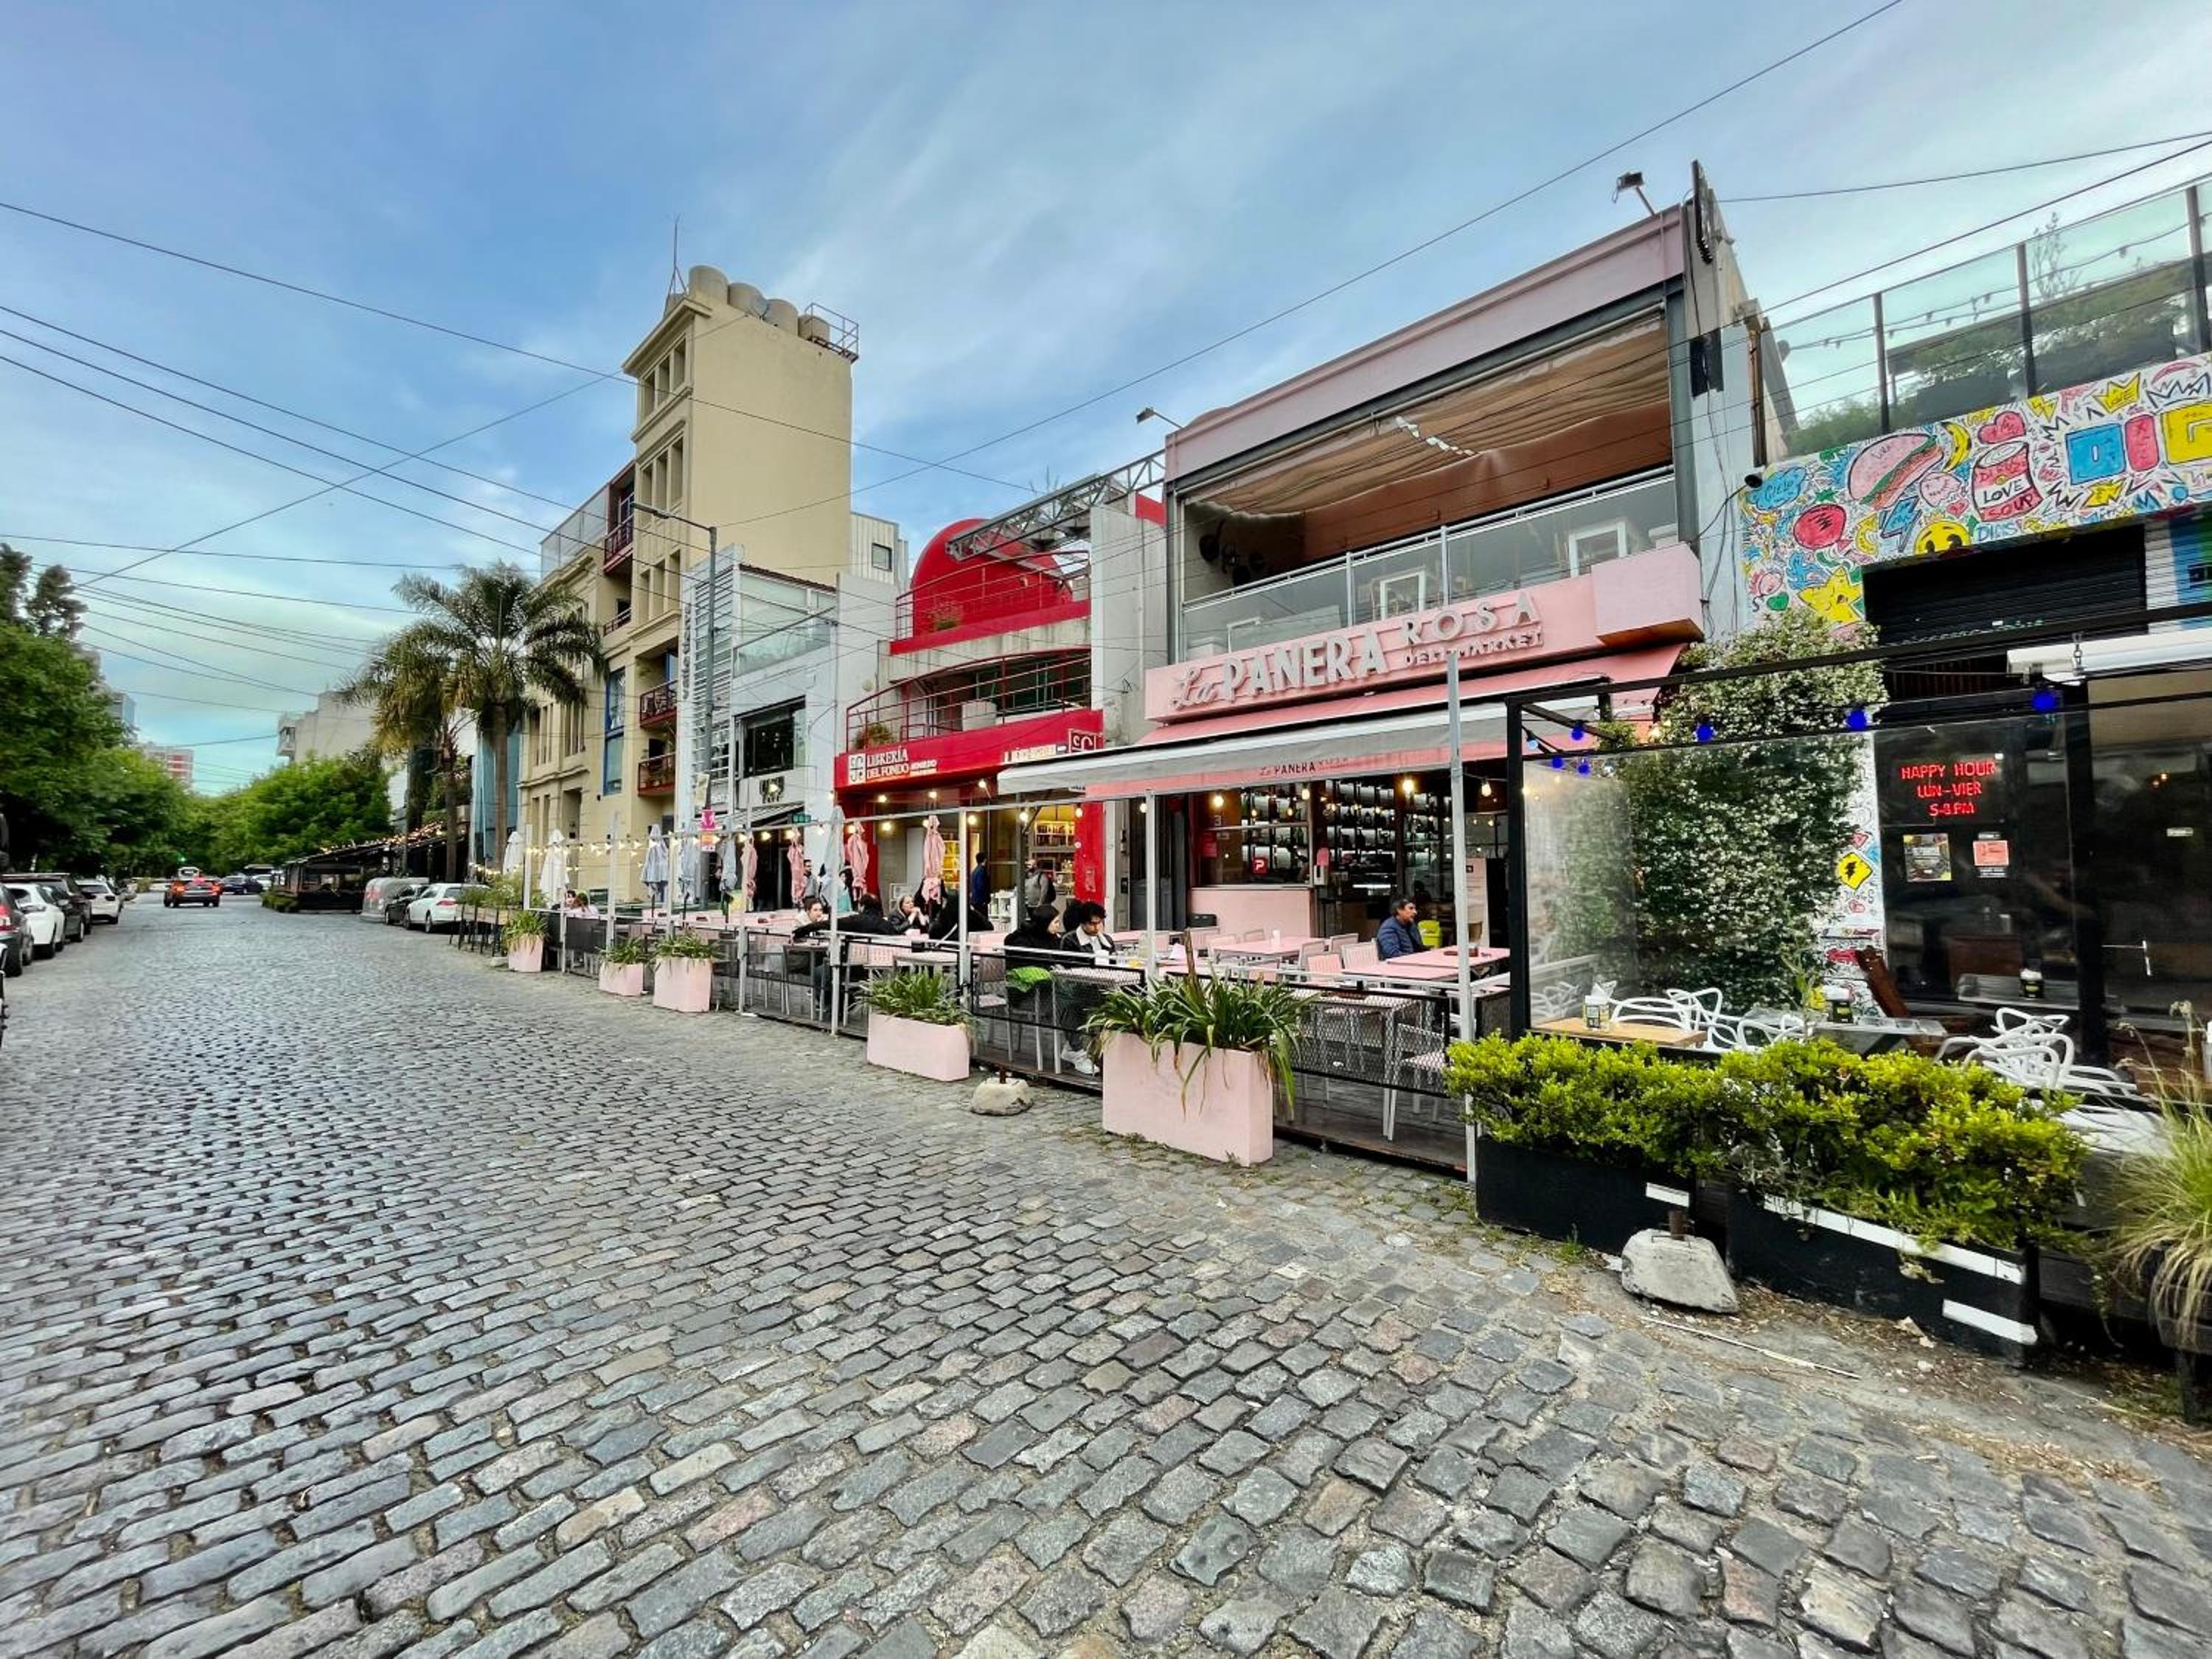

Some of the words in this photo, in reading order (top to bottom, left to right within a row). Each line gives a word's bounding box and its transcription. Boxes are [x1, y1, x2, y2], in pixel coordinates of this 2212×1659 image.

[1983, 478, 2025, 504] LOVE
[1988, 493, 2033, 516] SOUP
[1172, 667, 1217, 711] La
[1222, 627, 1390, 703] PANERA
[1401, 591, 1541, 645] ROSA
[867, 768, 881, 779] DEL
[881, 763, 910, 777] FONDO
[1274, 761, 1316, 774] PANERA
[1901, 764, 1947, 779] HAPPY
[1954, 760, 1997, 777] HOUR
